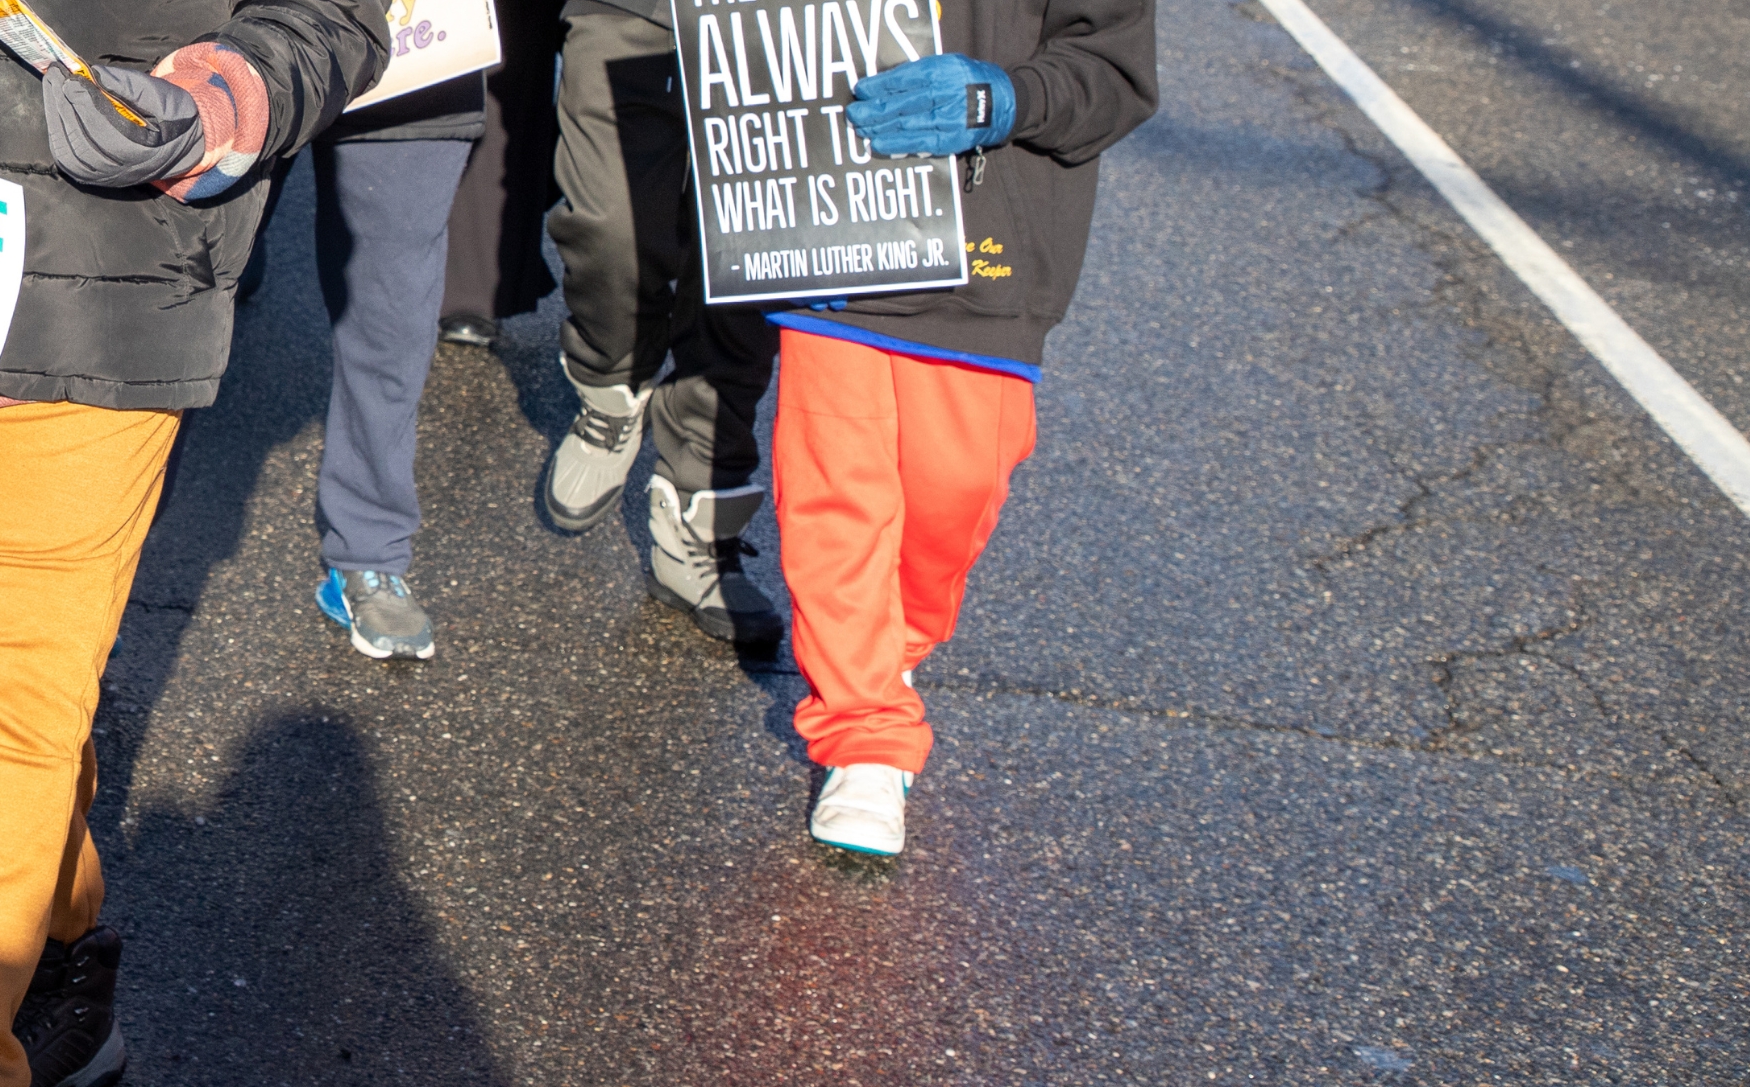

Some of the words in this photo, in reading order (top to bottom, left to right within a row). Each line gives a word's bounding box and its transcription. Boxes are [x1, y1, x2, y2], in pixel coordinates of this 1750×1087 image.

[704, 106, 812, 178] RIGHT
[710, 177, 798, 235] WHAT
[808, 173, 839, 228] IS
[849, 164, 944, 225] RIGHT.
[744, 248, 808, 283] MARTIN
[812, 244, 873, 276] LUTHER
[877, 241, 918, 273] KING
[922, 237, 950, 268] JR.
[970, 258, 1013, 282] Keeper
